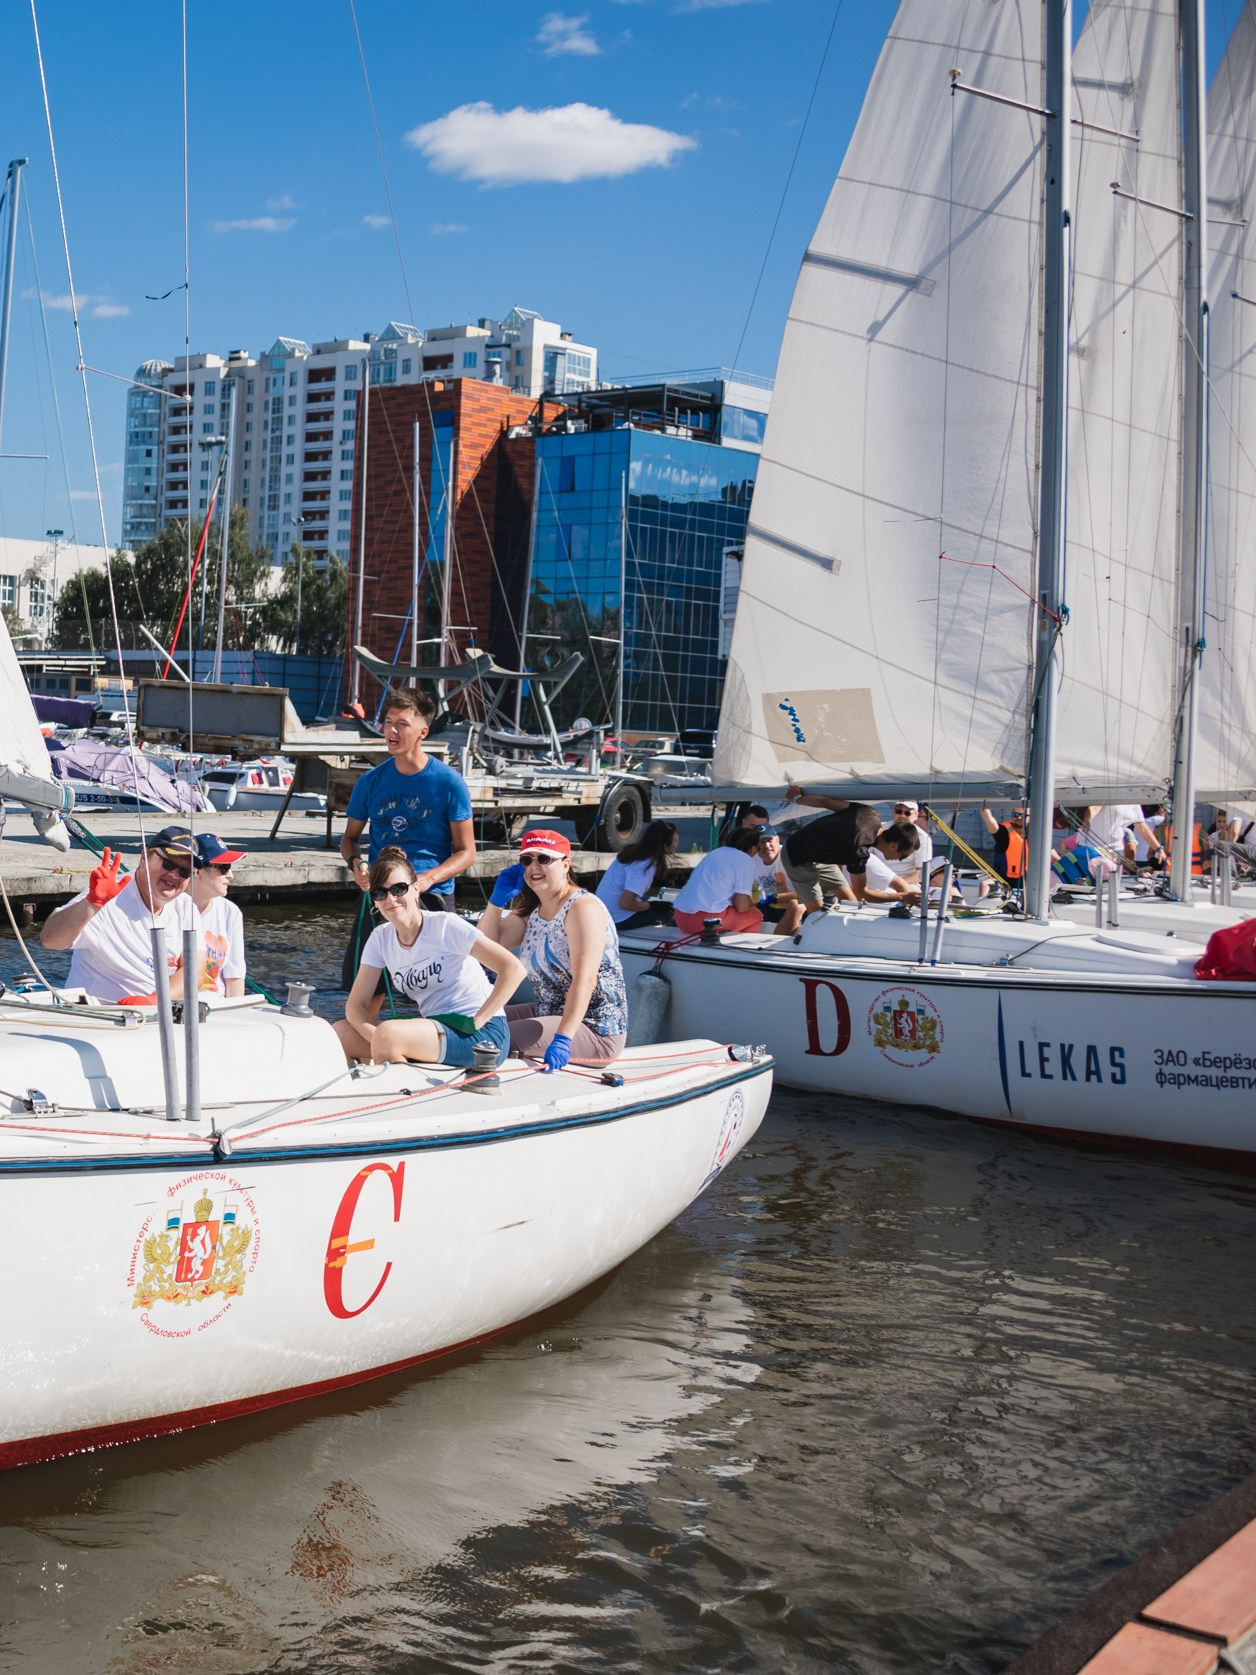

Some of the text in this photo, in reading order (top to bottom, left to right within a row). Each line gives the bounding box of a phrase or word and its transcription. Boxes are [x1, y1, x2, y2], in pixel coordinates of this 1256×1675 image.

[799, 978, 851, 1057] D
[1018, 1040, 1127, 1085] LEKAS
[1153, 1049, 1187, 1067] ЗАО
[167, 1171, 227, 1198] физической
[229, 1177, 257, 1216] культуры
[249, 1229, 261, 1273] спорта
[140, 1302, 232, 1338] Свердловской области
